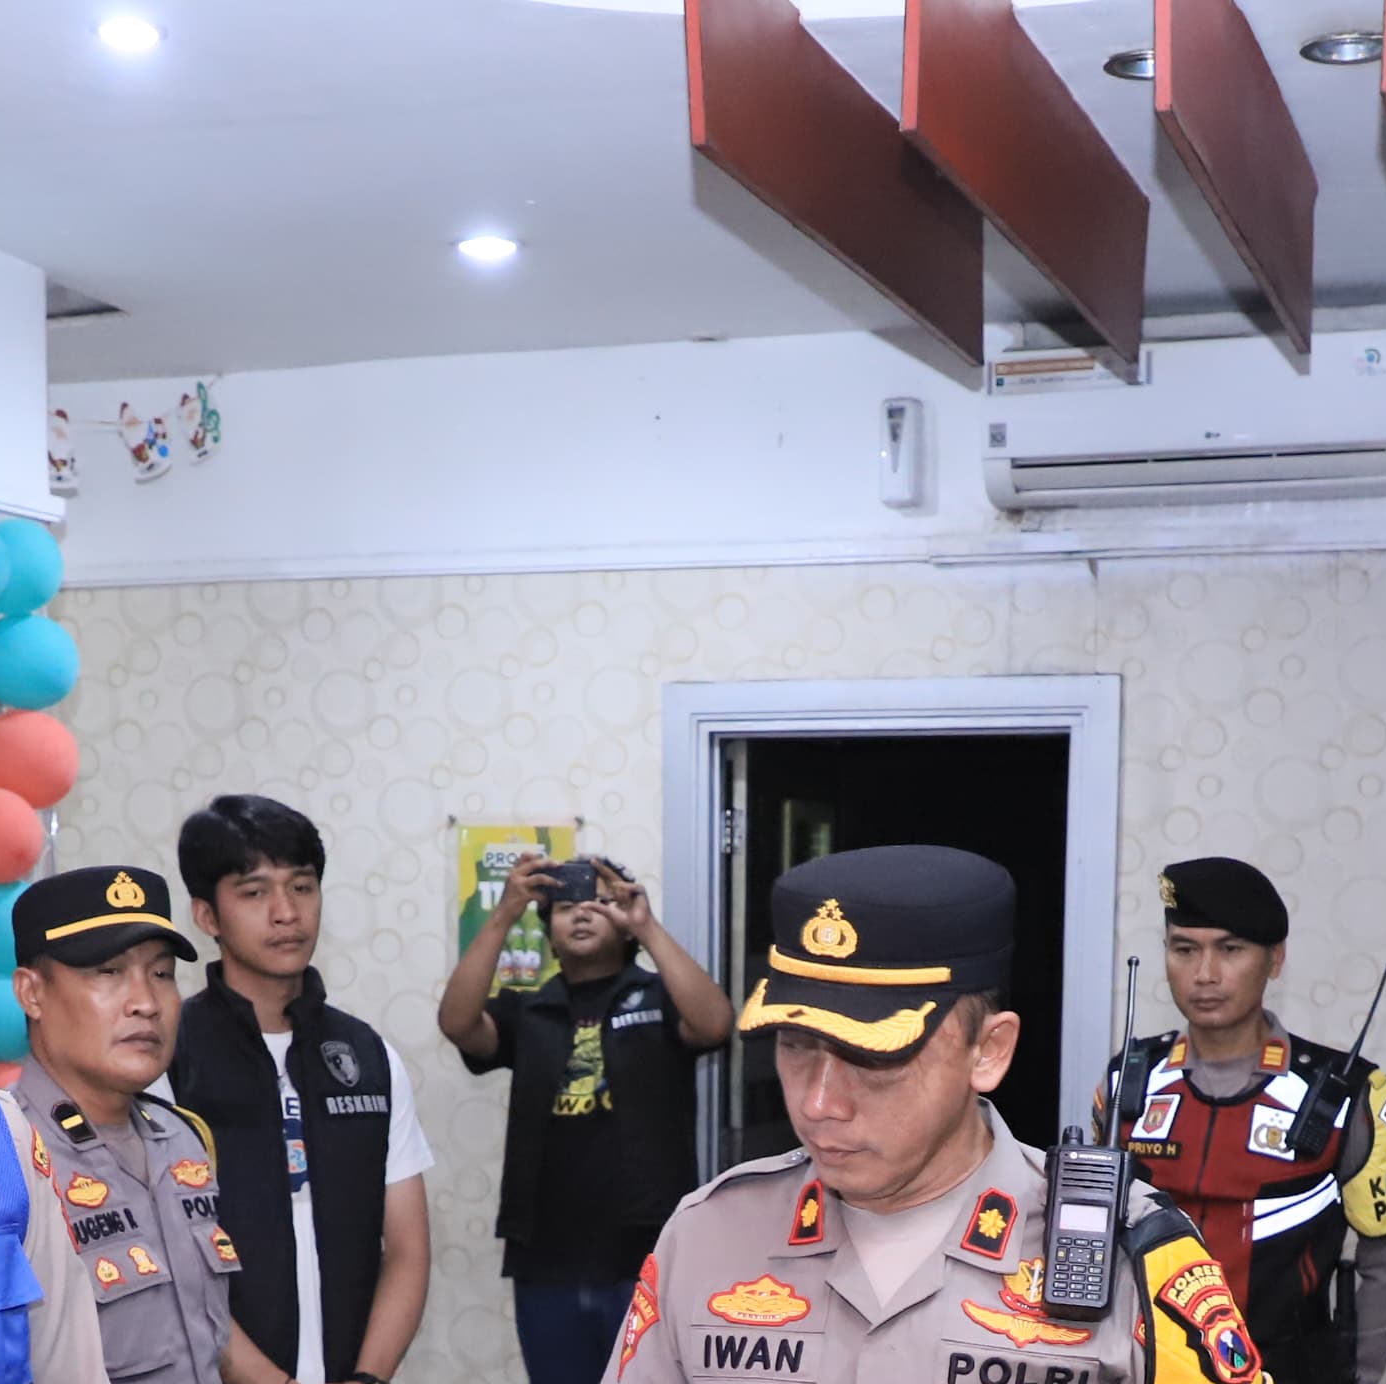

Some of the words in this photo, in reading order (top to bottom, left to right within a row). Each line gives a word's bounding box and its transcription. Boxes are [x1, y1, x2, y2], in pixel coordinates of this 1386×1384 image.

[485, 851, 547, 868] PRO
[1127, 1142, 1163, 1154] PRIYO
[1167, 1143, 1177, 1155] H
[181, 1195, 219, 1219] POL
[74, 1210, 126, 1245] UGENG
[1166, 1264, 1221, 1302] POLRES
[703, 1334, 805, 1374] IWAN
